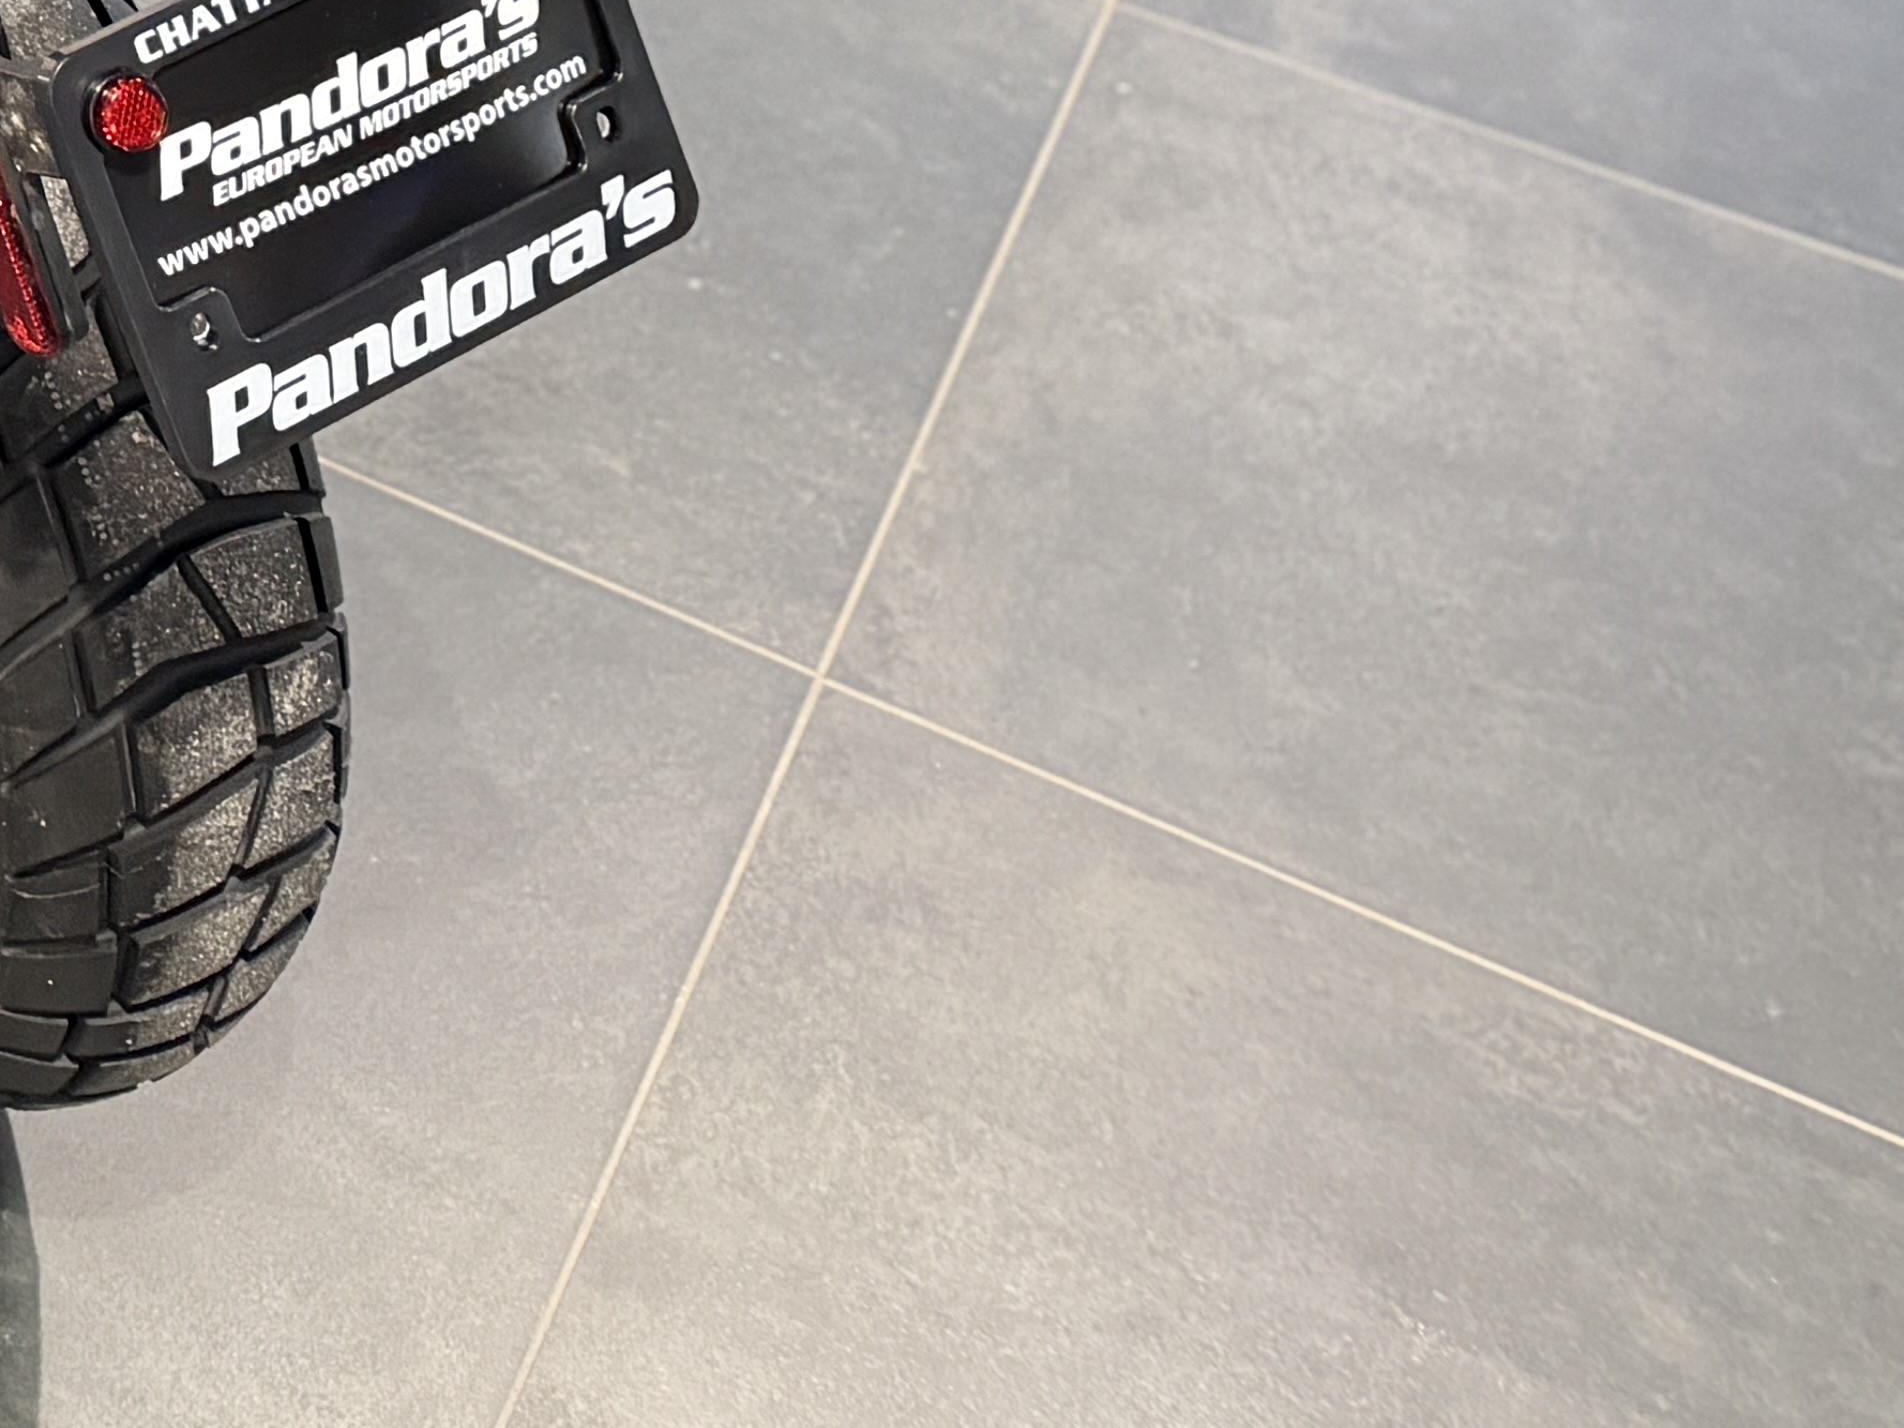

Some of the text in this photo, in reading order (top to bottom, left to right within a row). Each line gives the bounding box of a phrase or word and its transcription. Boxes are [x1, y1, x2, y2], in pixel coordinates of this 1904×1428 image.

[158, 53, 587, 276] www.pandorasmotorsports.com
[211, 32, 538, 207] EUROPEAN MOTORSPORTS
[207, 168, 677, 466] Pandora's
